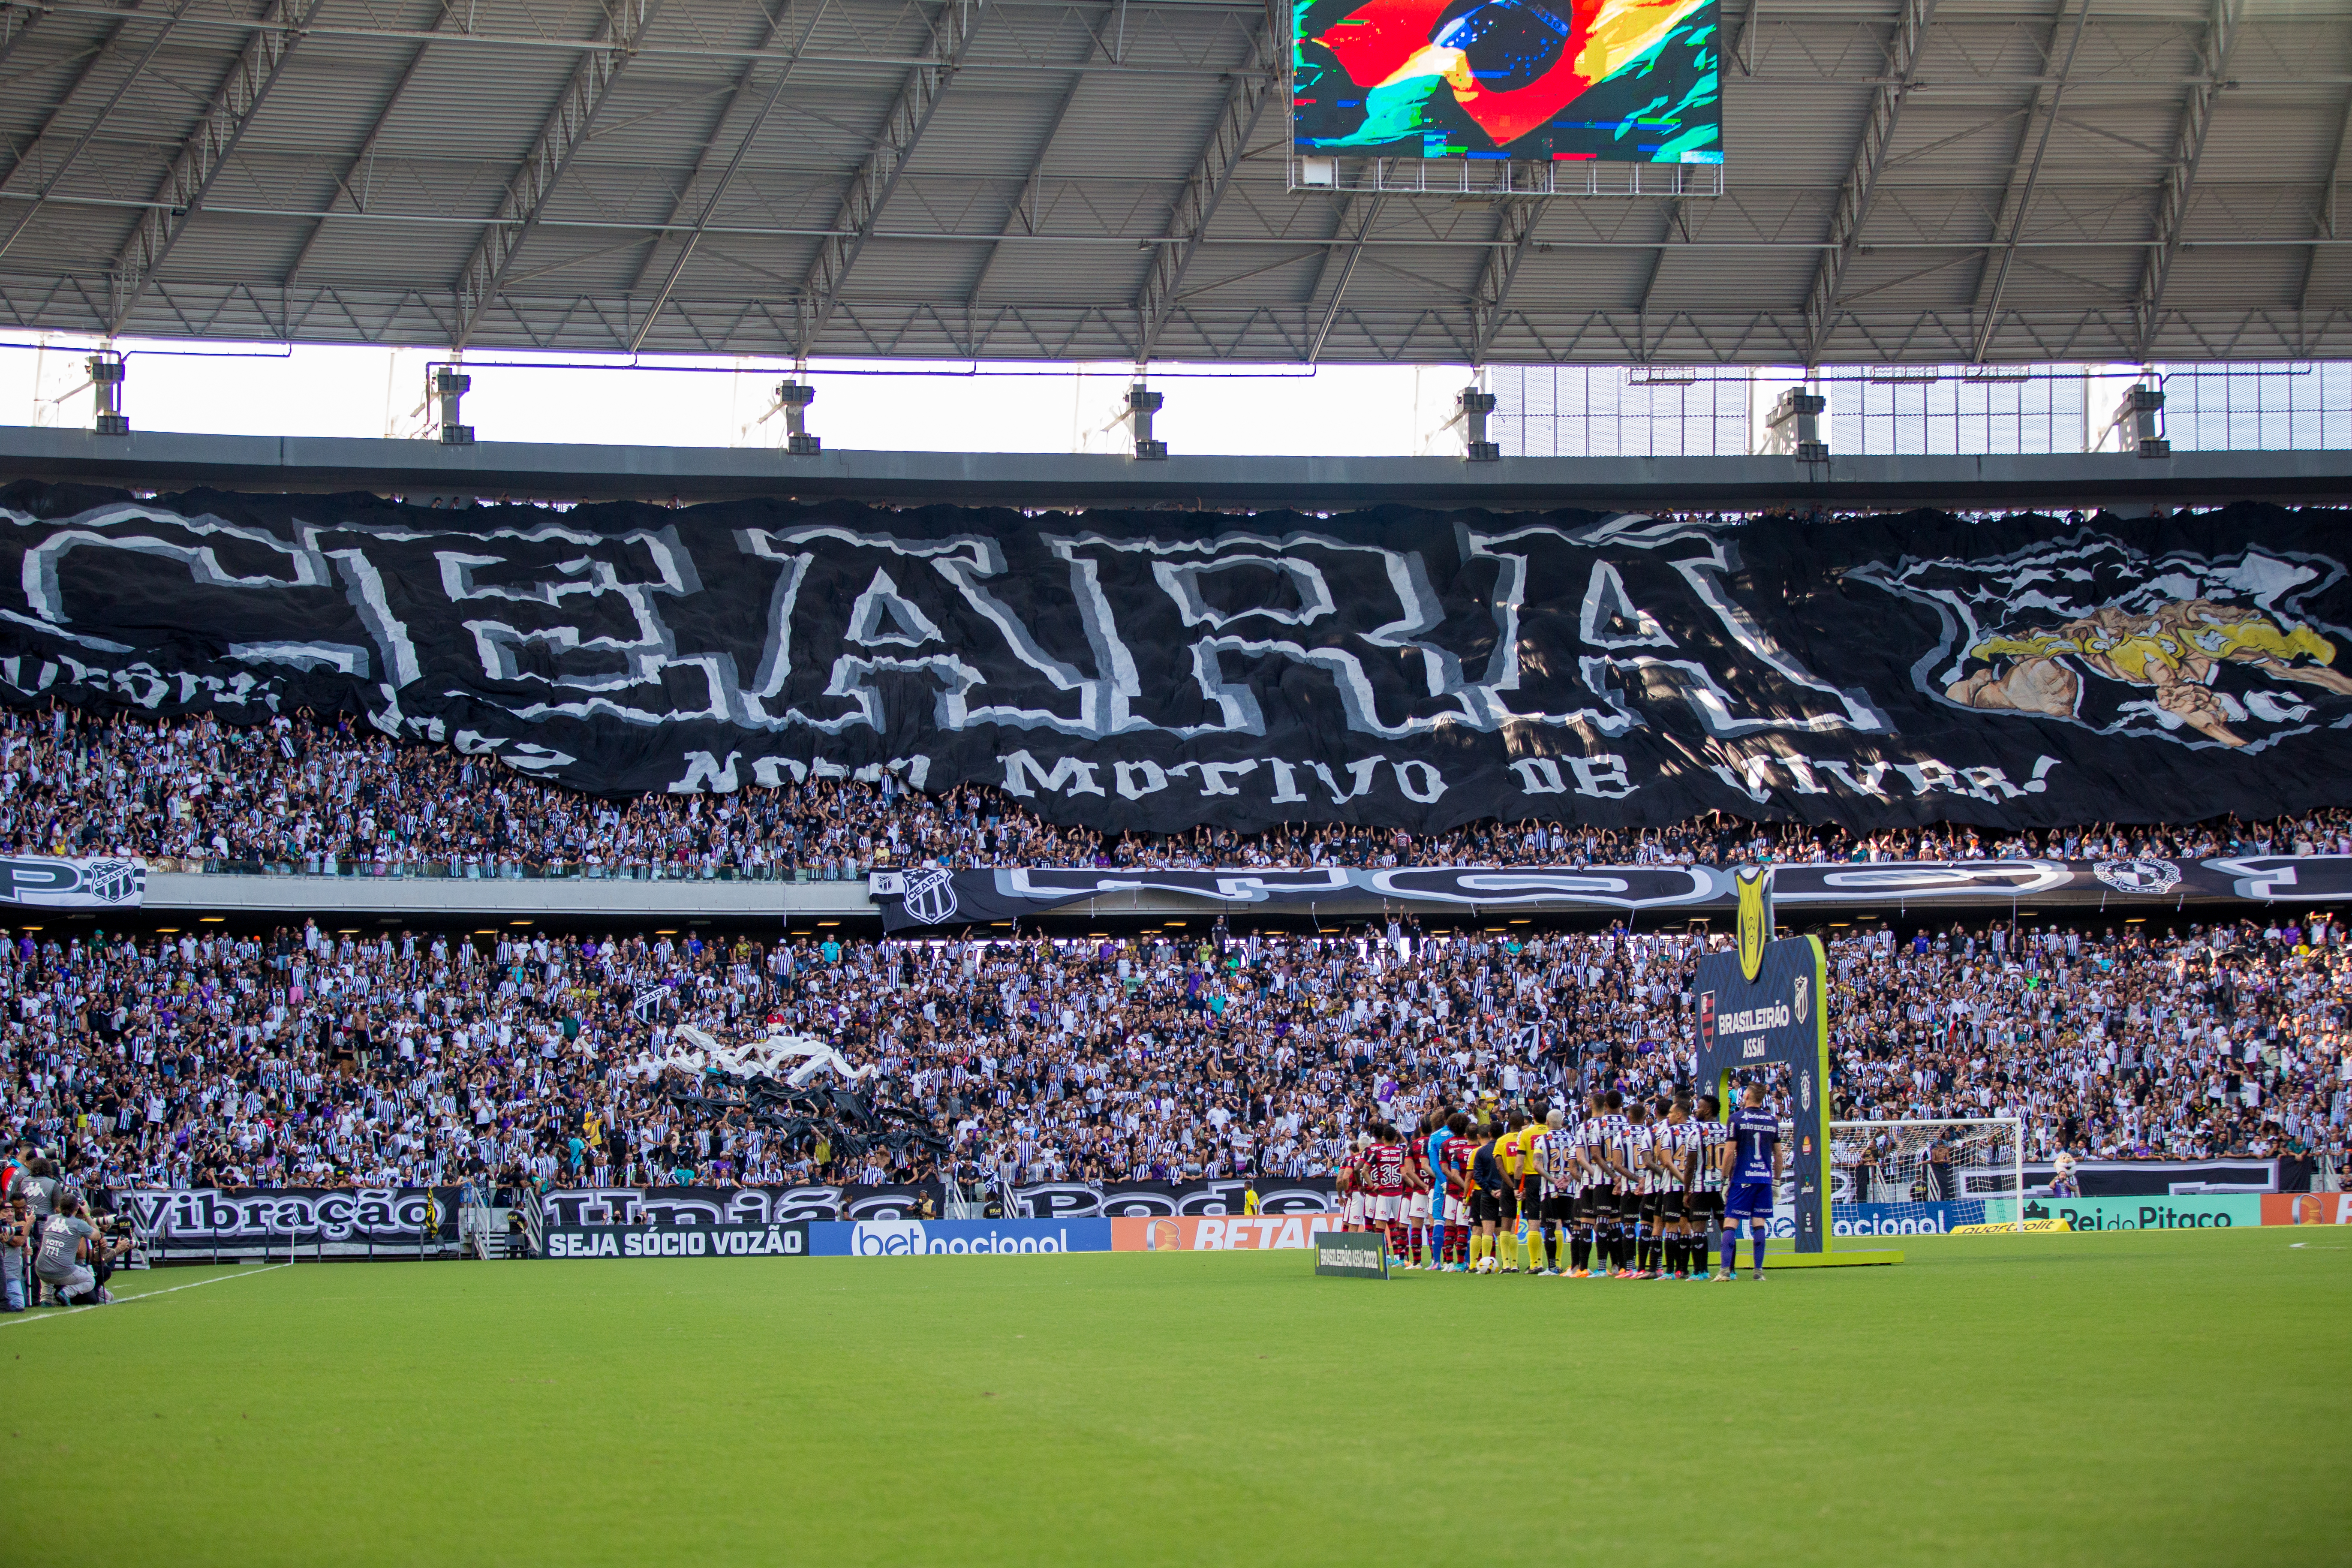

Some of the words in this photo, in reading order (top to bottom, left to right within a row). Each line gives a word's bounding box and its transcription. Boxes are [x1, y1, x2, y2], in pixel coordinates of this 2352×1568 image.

[997, 749, 1448, 806] MOTIVO
[1509, 754, 1640, 799] DE
[1397, 838, 1407, 847] 82
[95, 867, 131, 887] CEARÁ
[908, 872, 944, 900] CEARÁ
[1718, 999, 1790, 1035] BRASILEIRÃO
[1382, 1086, 1389, 1095] 9
[1748, 1112, 1772, 1120] brisanet
[1754, 1124, 1777, 1133] RICARDO
[1877, 1111, 1886, 1122] 10
[1753, 1132, 1762, 1160] 1
[1380, 1163, 1402, 1186] 35
[120, 1189, 444, 1239] Vibração
[1833, 1210, 1947, 1236] acional
[2059, 1207, 2102, 1231] Rei
[2107, 1214, 2135, 1230] do
[2139, 1206, 2231, 1228] Pitaco
[46, 1239, 65, 1247] FOTO
[549, 1233, 619, 1257] SEJA
[624, 1226, 706, 1256] SÓCIO
[710, 1225, 802, 1255] VOZÃO
[859, 1226, 920, 1256] bet
[929, 1228, 1068, 1254] nacional
[1320, 1244, 1352, 1267] BRASILEIRÃO
[1363, 1250, 1379, 1269] 2022
